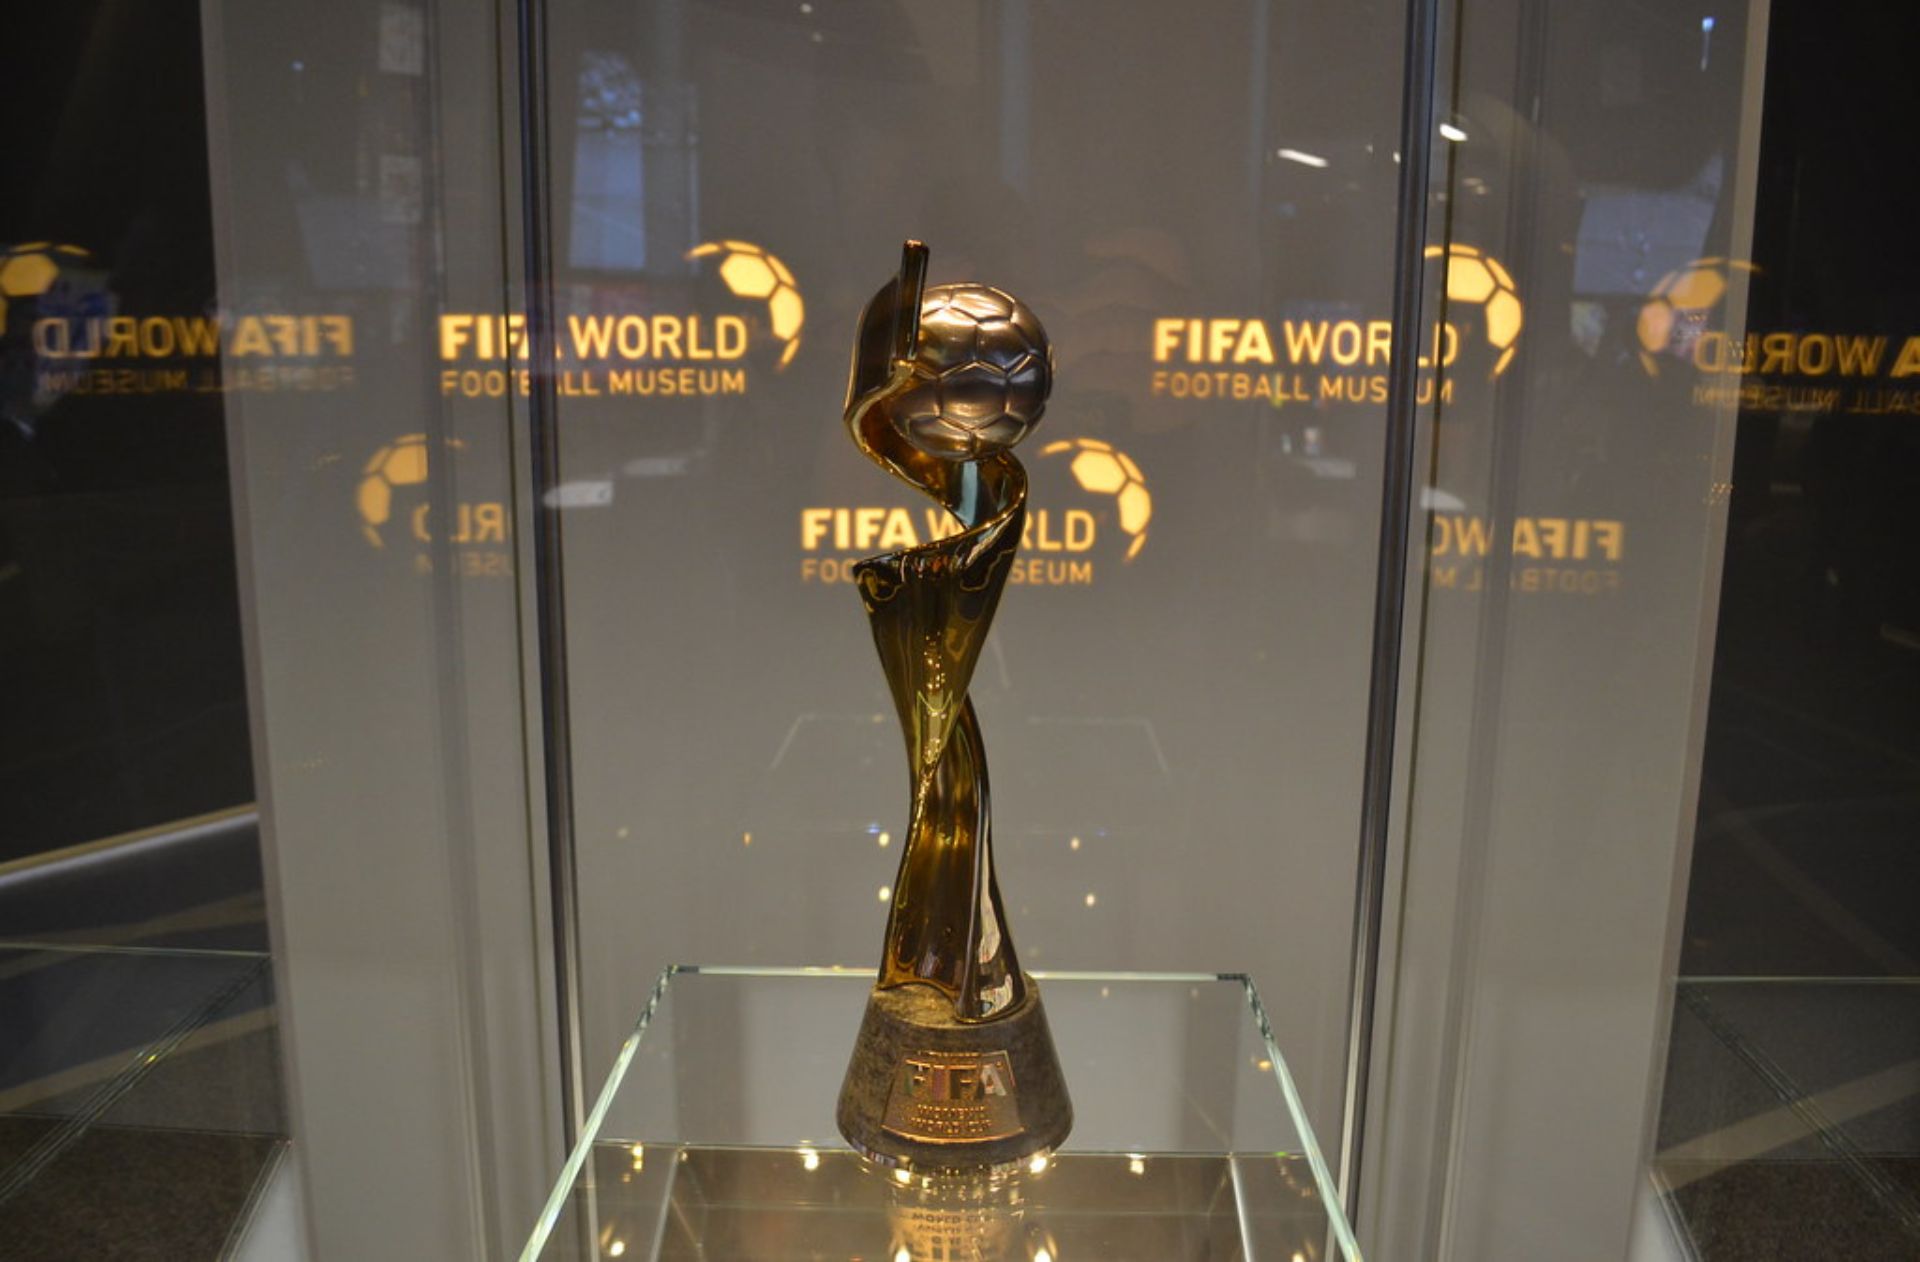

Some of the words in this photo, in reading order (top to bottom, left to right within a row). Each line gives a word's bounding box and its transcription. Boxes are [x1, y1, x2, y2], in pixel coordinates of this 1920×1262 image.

[568, 315, 747, 360] WORLD
[1153, 318, 1277, 364] FIFA
[609, 369, 746, 396] MUSEUM
[1153, 371, 1311, 401] FOOTBALL
[802, 507, 919, 550] FIFA
[904, 1059, 1006, 1099] FIFA
